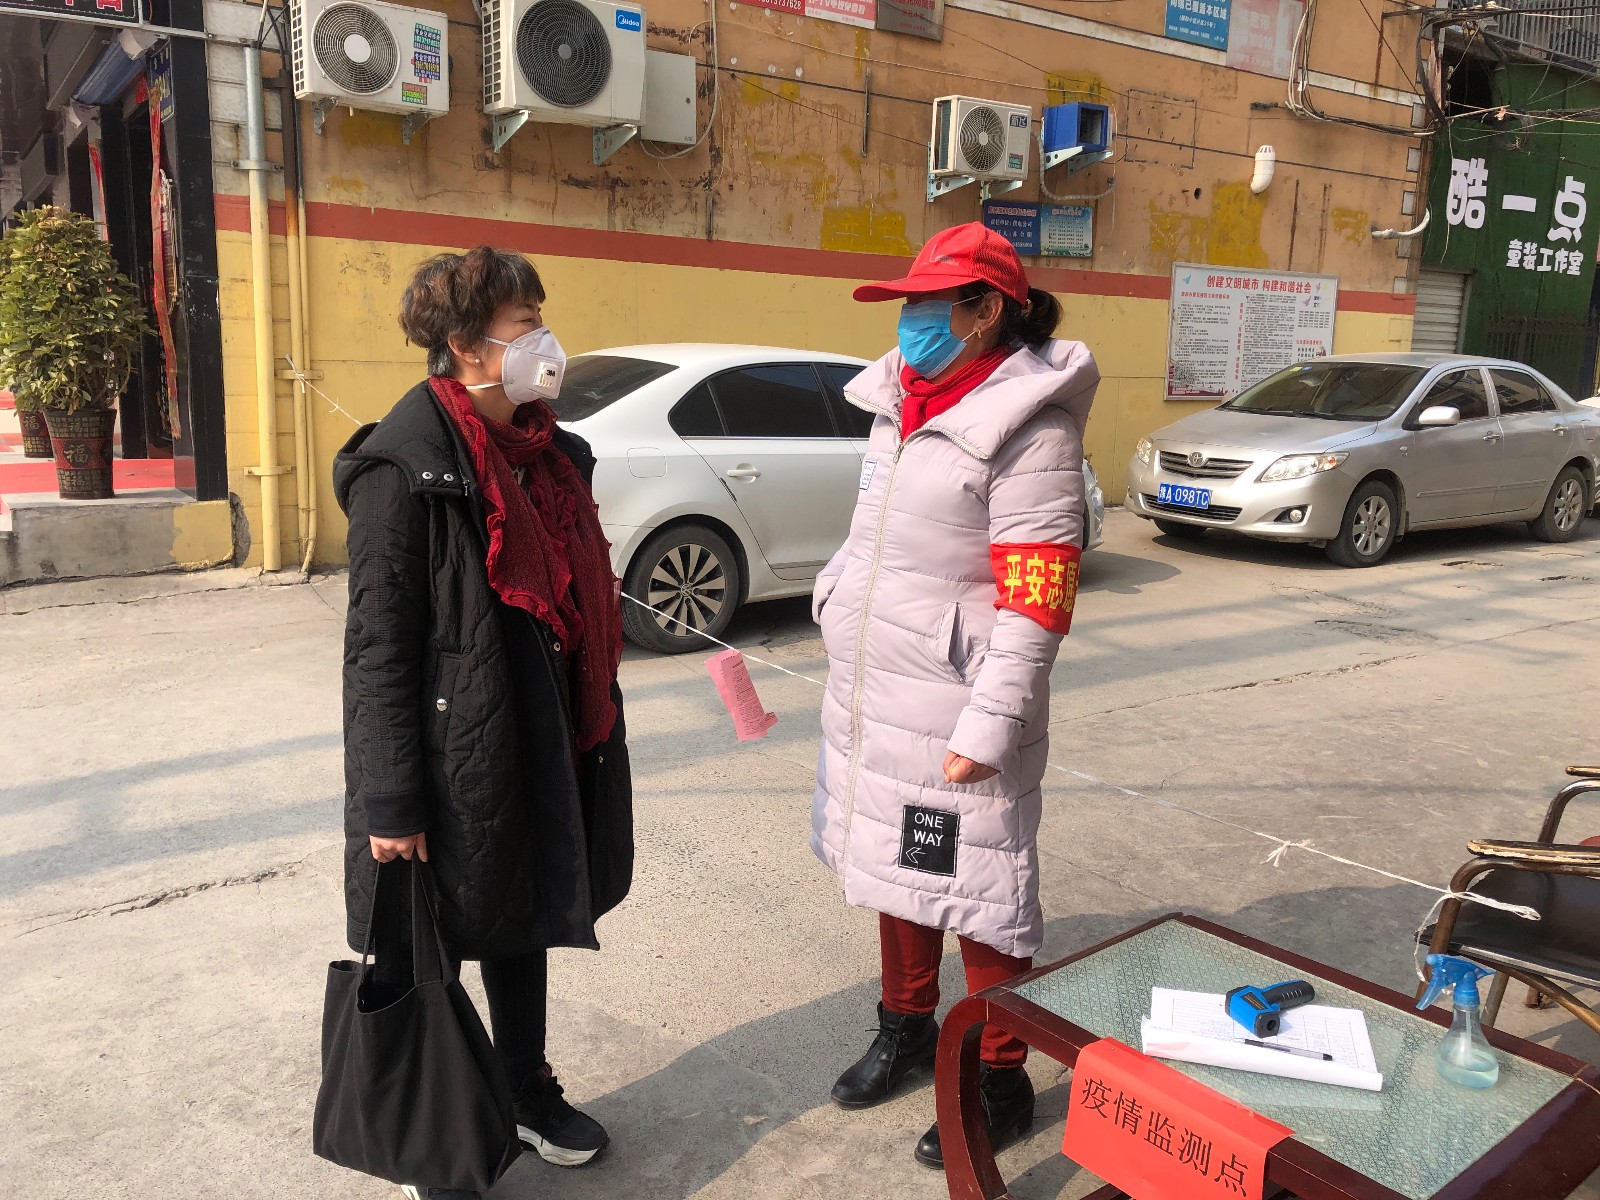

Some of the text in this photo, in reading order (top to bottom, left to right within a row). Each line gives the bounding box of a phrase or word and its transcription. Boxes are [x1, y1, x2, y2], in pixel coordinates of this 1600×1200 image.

[758, 0, 802, 10] 3737628
[1446, 157, 1587, 244] 酷一点
[1505, 238, 1584, 276] 童装工作室
[1206, 274, 1312, 294] 创建文明城市 构建和谐社会
[546, 369, 556, 377] 3M
[63, 443, 88, 463] 福
[1004, 552, 1080, 613] 平安志愿
[914, 812, 944, 829] ONE
[913, 829, 944, 847] WAY
[1080, 1077, 1249, 1197] 疫情监测点
